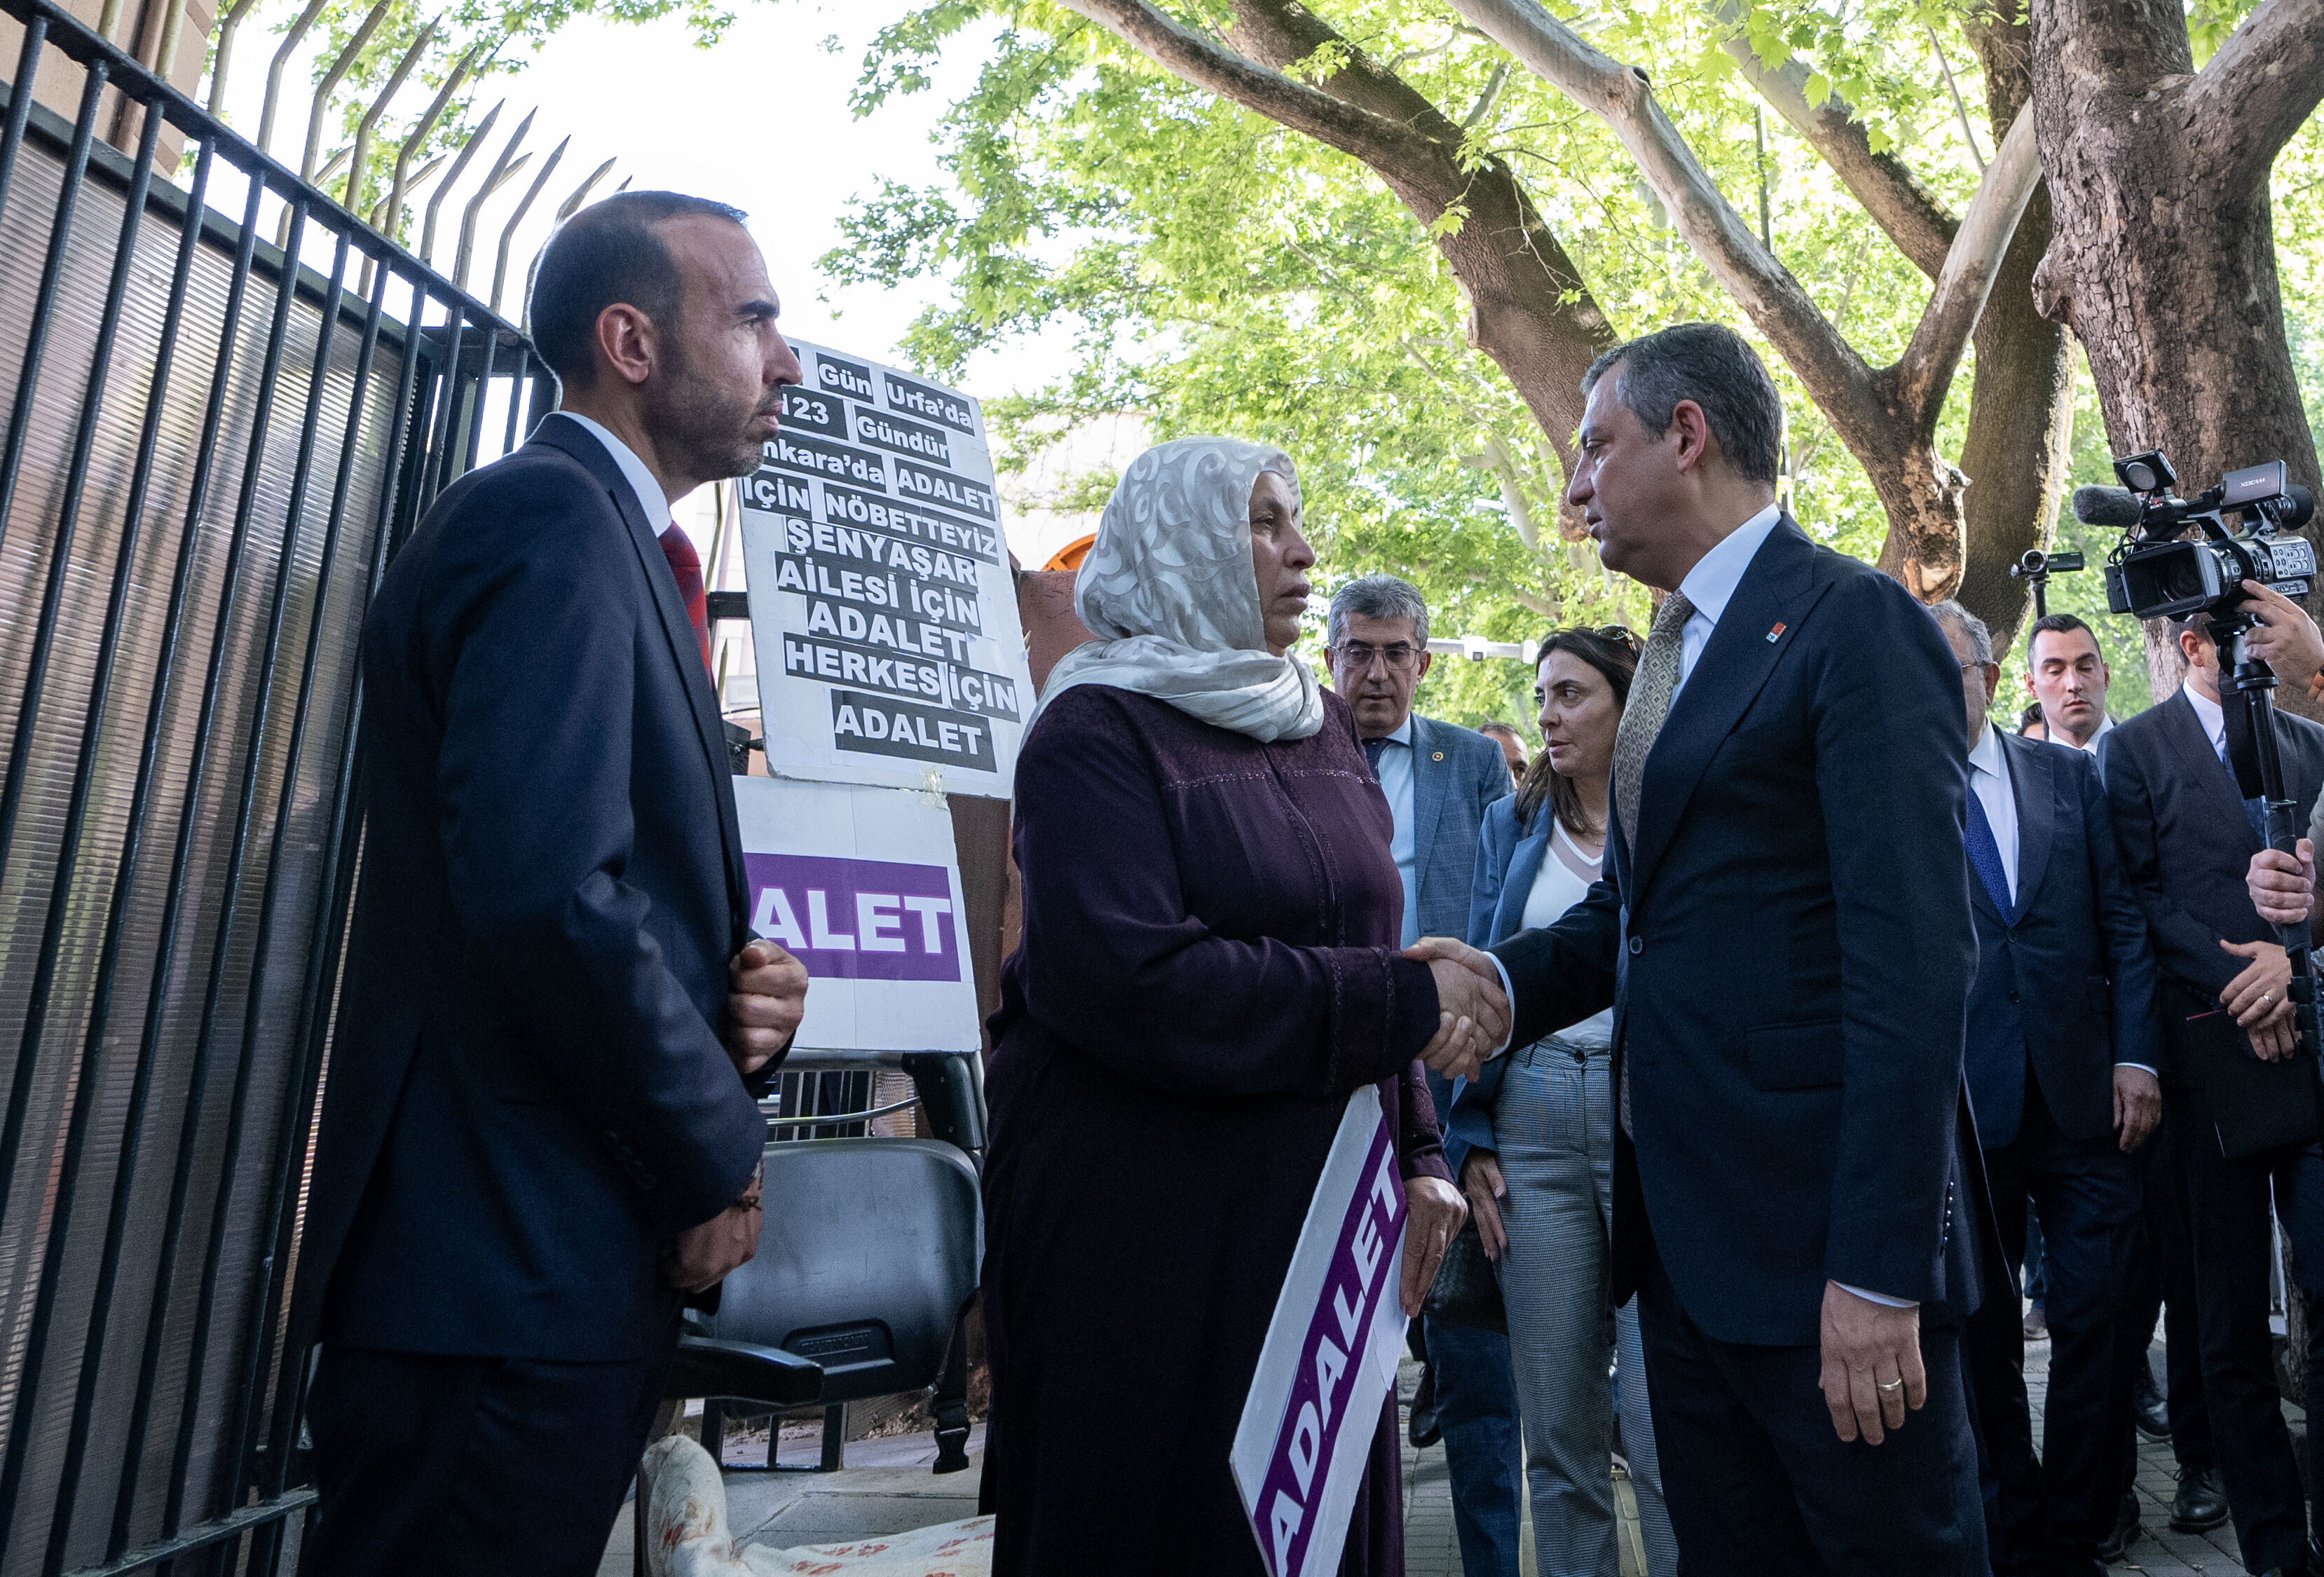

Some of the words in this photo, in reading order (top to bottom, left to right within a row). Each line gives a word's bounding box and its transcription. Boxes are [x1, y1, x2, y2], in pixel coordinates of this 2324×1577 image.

[819, 363, 873, 397] Gün
[887, 382, 972, 429] Urfa'da
[856, 416, 948, 459] Gündür
[763, 438, 886, 486] nkara'da
[898, 470, 992, 513] ADALET
[787, 519, 978, 586] ŞENYAŞAR
[825, 492, 999, 558] NÖBETTEYİZ
[777, 557, 901, 608] AİLESİ
[910, 579, 980, 627] İÇİN
[808, 601, 966, 661] ADALET
[785, 640, 941, 695] HERKES
[949, 665, 1018, 713] İÇİN
[835, 705, 981, 755] ADALET
[751, 888, 952, 954] ALET
[1271, 1140, 1397, 1577] ADALET
